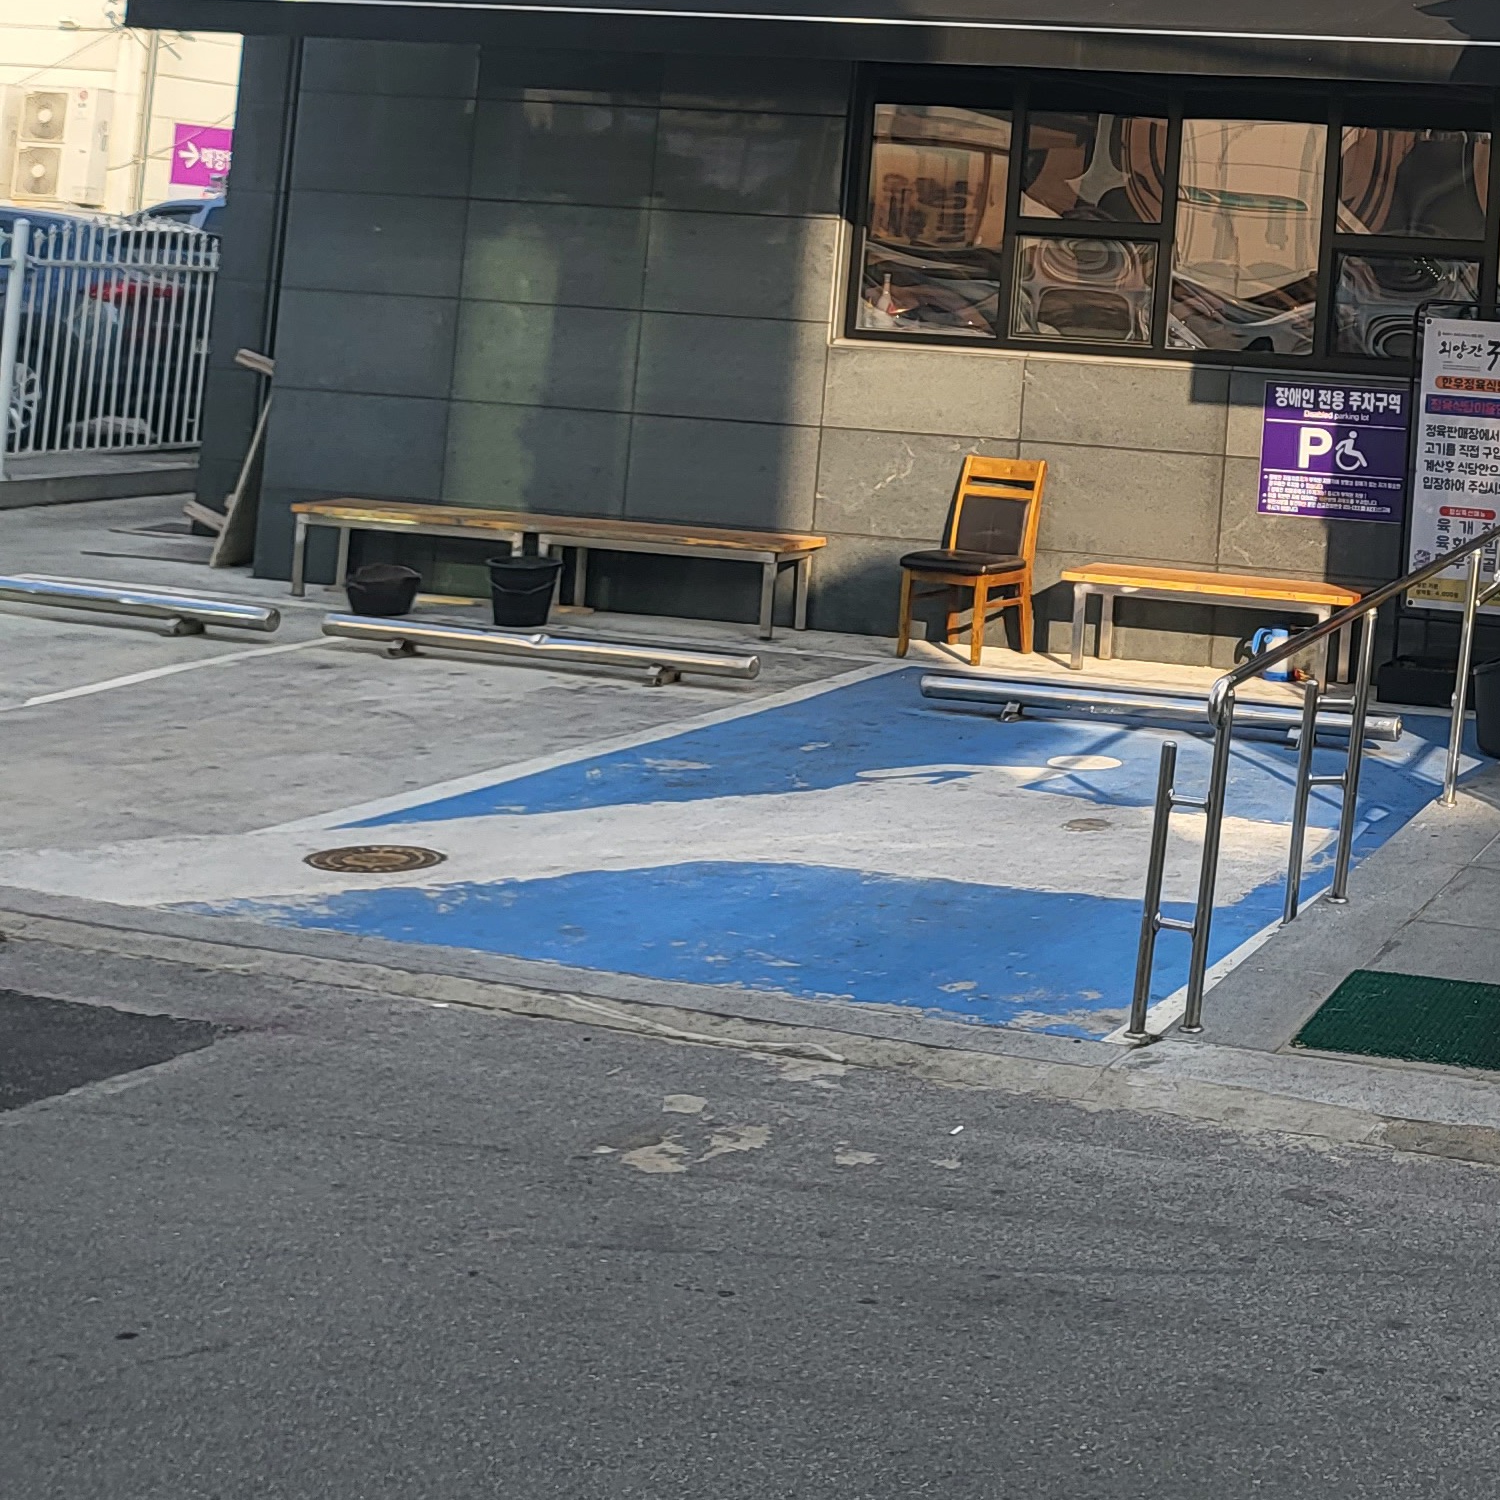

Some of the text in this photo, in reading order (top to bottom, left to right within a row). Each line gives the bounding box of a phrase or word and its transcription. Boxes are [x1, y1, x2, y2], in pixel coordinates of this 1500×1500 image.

[1438, 340, 1483, 360] 외양간
[1275, 386, 1402, 414] 장애인 전용 주차구역
[1334, 412, 1360, 422] parking
[1425, 424, 1500, 443] 정육판매장에서
[1299, 426, 1333, 469] P
[1424, 442, 1455, 458] 고기를
[1458, 443, 1480, 459] 직접
[1424, 459, 1455, 474] 계산후
[1423, 476, 1466, 492] 입장하여
